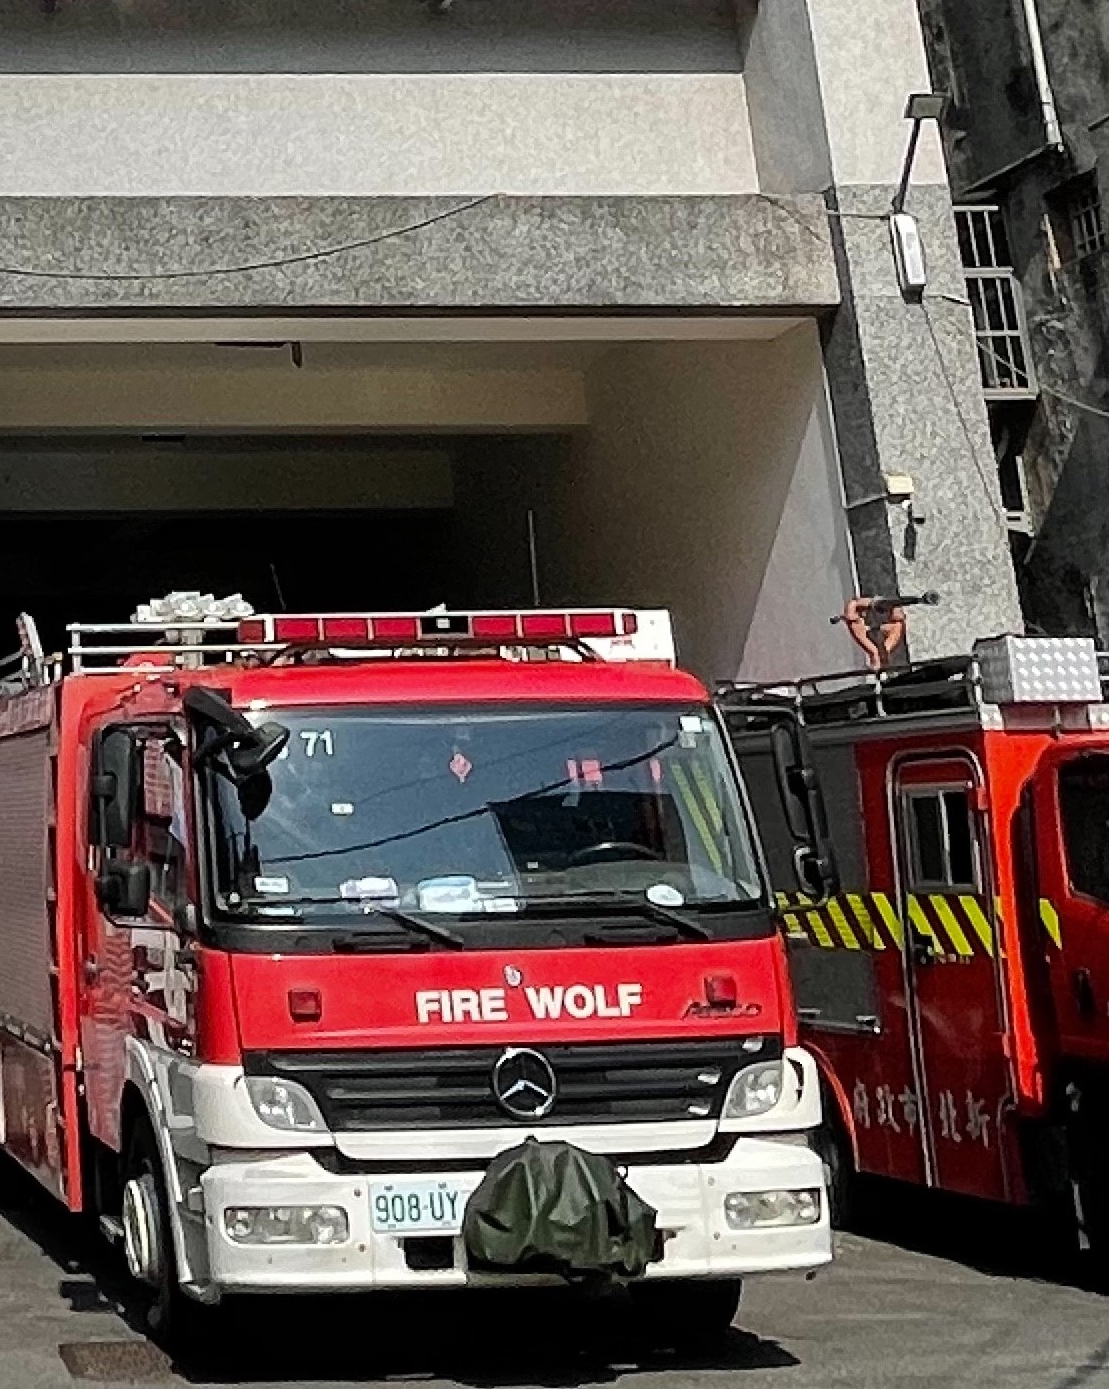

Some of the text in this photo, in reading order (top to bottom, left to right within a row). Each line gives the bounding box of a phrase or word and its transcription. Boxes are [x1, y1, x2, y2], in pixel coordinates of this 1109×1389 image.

[299, 730, 334, 757] 71
[416, 988, 509, 1023] FIRE
[524, 983, 643, 1020] WOLF
[375, 1191, 459, 1223] 908-UY
